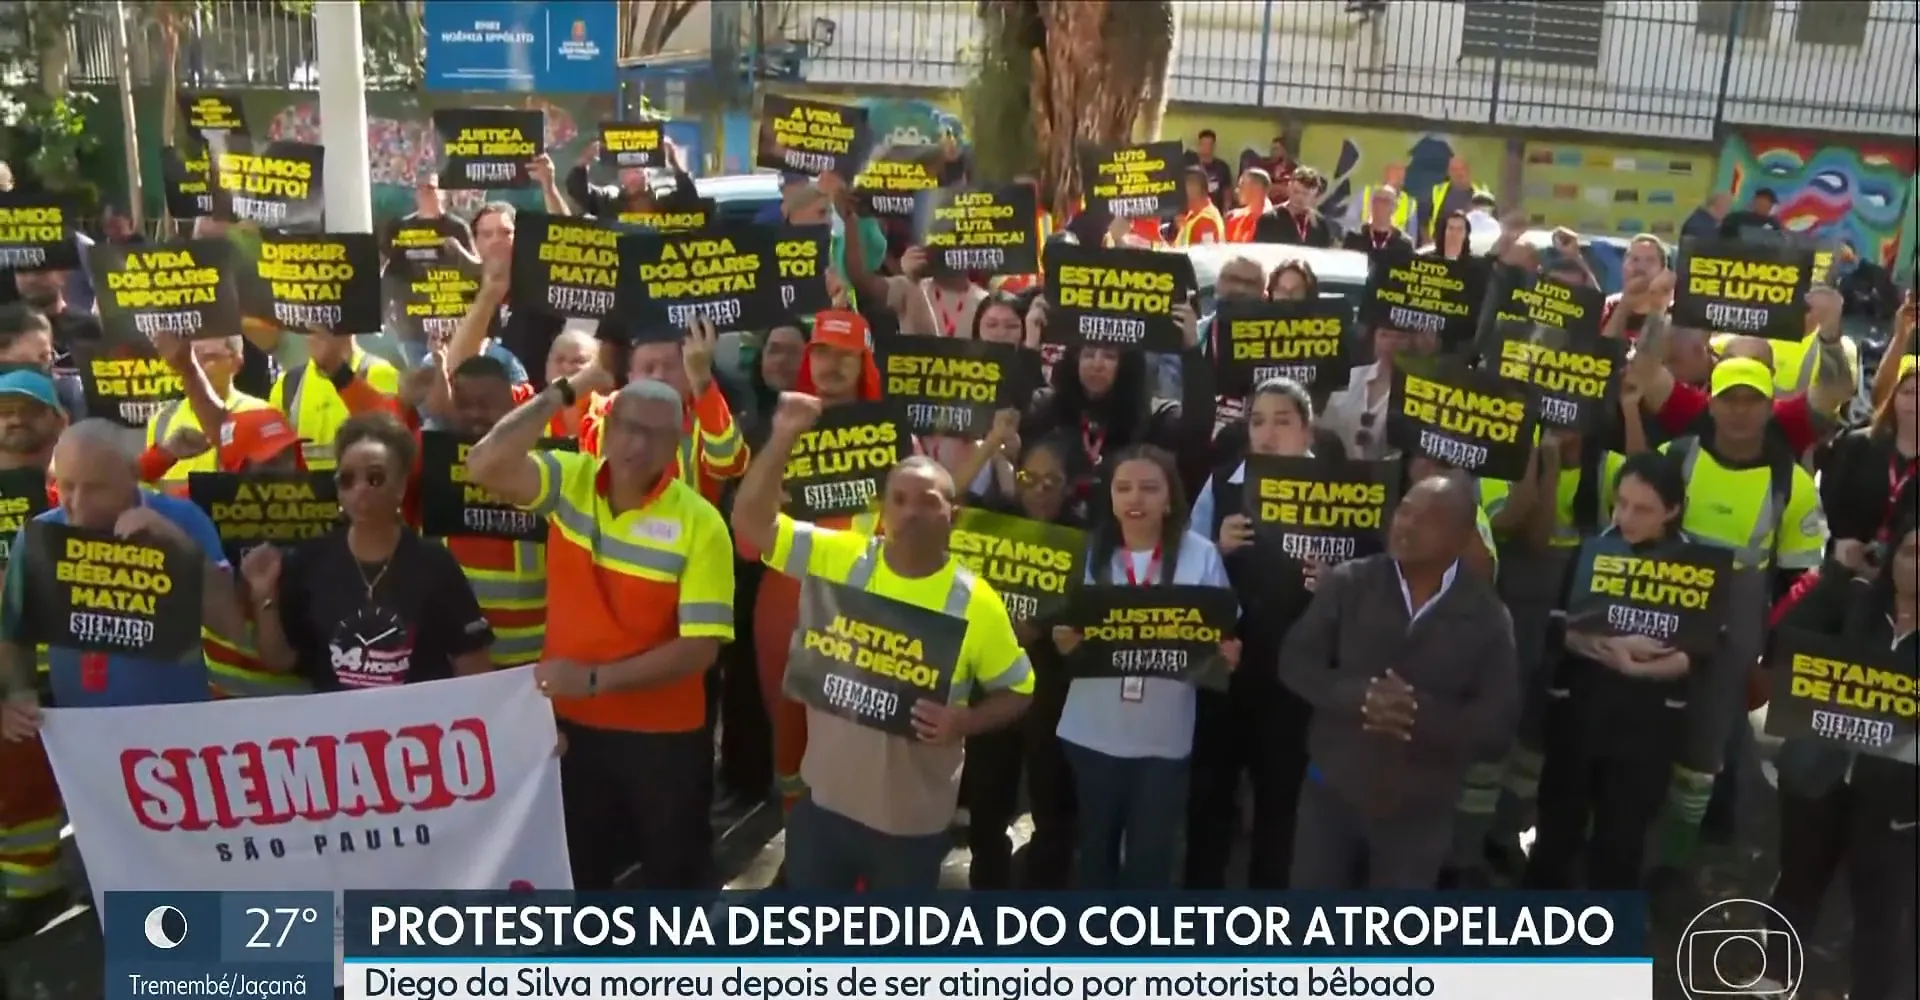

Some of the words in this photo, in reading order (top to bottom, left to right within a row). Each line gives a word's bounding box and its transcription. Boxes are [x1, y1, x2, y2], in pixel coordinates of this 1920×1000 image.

[774, 117, 807, 133] DOS
[808, 122, 855, 139] GARIS
[790, 107, 802, 120] A
[805, 109, 842, 124] VIDA
[457, 128, 524, 143] JUSTIÇA
[445, 143, 480, 156] POR
[1113, 150, 1147, 163] LUTO
[218, 153, 312, 178] ESTAMOS
[1098, 162, 1128, 175] POR
[219, 171, 242, 193] DE
[245, 173, 309, 199] LUTO!
[955, 192, 994, 205] LUTO
[935, 206, 965, 219] POR
[125, 253, 144, 271] A
[145, 249, 196, 269] VIDA
[261, 241, 347, 264] DIRIGIR
[539, 241, 620, 268] BÊBAD
[661, 243, 679, 262] A
[679, 237, 737, 260] VIDA
[107, 271, 153, 291] DOS
[154, 267, 220, 287] GARIS
[550, 264, 618, 288] MATA!
[639, 261, 688, 282] DOS
[690, 253, 761, 277] GARIS
[1059, 265, 1175, 292] ESTAMOS
[1689, 256, 1799, 285] ESTAMOS
[115, 285, 217, 308] IMPORTA!
[271, 282, 342, 303] MATA!
[648, 272, 757, 299] IMPORTA!
[1534, 281, 1571, 300] LUTO
[1689, 278, 1720, 297] DE
[1724, 280, 1795, 305] LUTO!
[1060, 287, 1095, 309] DE
[1098, 289, 1171, 314] LUTO!
[1231, 318, 1342, 340] ESTAMOS
[1233, 340, 1267, 360] DE
[1270, 338, 1339, 359] LUTO!
[1501, 339, 1613, 378] ESTAMOS
[91, 358, 174, 378] ESTAM
[887, 355, 1001, 382] ESTAMOS
[1499, 361, 1530, 383] DE
[1533, 369, 1607, 399] LUTO!
[96, 379, 128, 396] DE
[887, 376, 921, 396] DE
[924, 379, 997, 402] LUTO!
[1404, 373, 1526, 424] ESTAMOS
[1403, 396, 1437, 424] DE
[1439, 410, 1519, 444] LUTO!
[791, 422, 897, 454] STAMOS
[818, 445, 898, 474] LUTO!
[234, 483, 255, 501] A
[256, 483, 316, 501] VIDA
[1260, 477, 1386, 504] ESTAMOS
[1261, 503, 1300, 525] DE
[1303, 505, 1381, 529] LUTO!
[65, 537, 165, 571] DIRIGIR
[948, 529, 1073, 572] ESTAMOS
[56, 559, 173, 595] BÊBADO
[988, 559, 1067, 594] LUTO!
[1593, 555, 1716, 589] ESTAMOS
[70, 585, 157, 616] MATA!
[1589, 574, 1628, 597] DE
[1629, 577, 1710, 611] LUTO!
[69, 611, 154, 643] SIEMACO
[1103, 607, 1204, 629] JUSTIÇA
[825, 614, 924, 662] JUSTIÇA
[1084, 626, 1133, 642] POR
[1139, 625, 1221, 643] DIEGO!
[804, 630, 852, 664] POR
[854, 650, 940, 691] DIEGO!
[1791, 676, 1831, 702] DE
[1811, 709, 1894, 744] SIEMACO
[119, 717, 496, 832] SIEMACO
[215, 836, 286, 863] SÃO
[314, 824, 432, 856] PAULO
